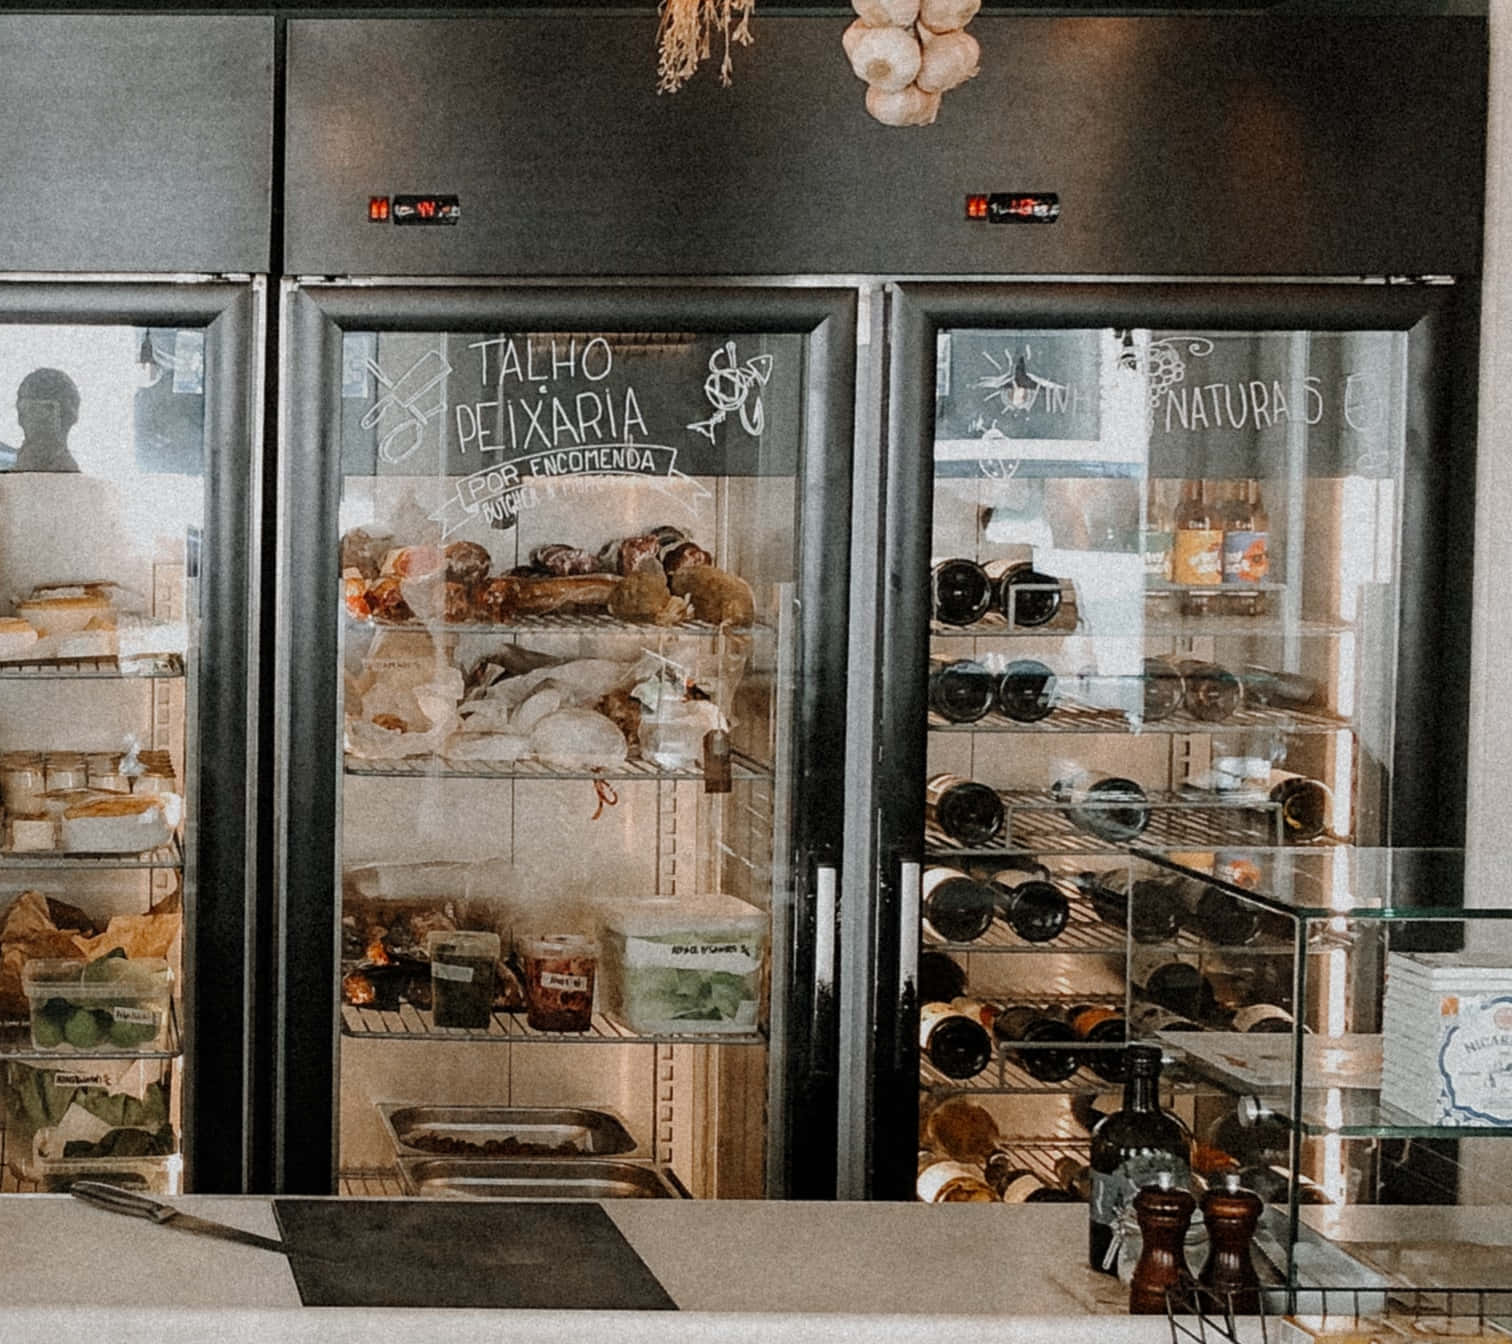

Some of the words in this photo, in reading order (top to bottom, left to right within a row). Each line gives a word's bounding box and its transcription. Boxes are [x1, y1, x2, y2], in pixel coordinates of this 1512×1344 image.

[468, 337, 613, 386] TALHO
[456, 386, 649, 453] PEIXARIA
[1165, 376, 1323, 433] NATURAS
[468, 464, 521, 501] POR
[529, 447, 656, 478] ENCOMENDA
